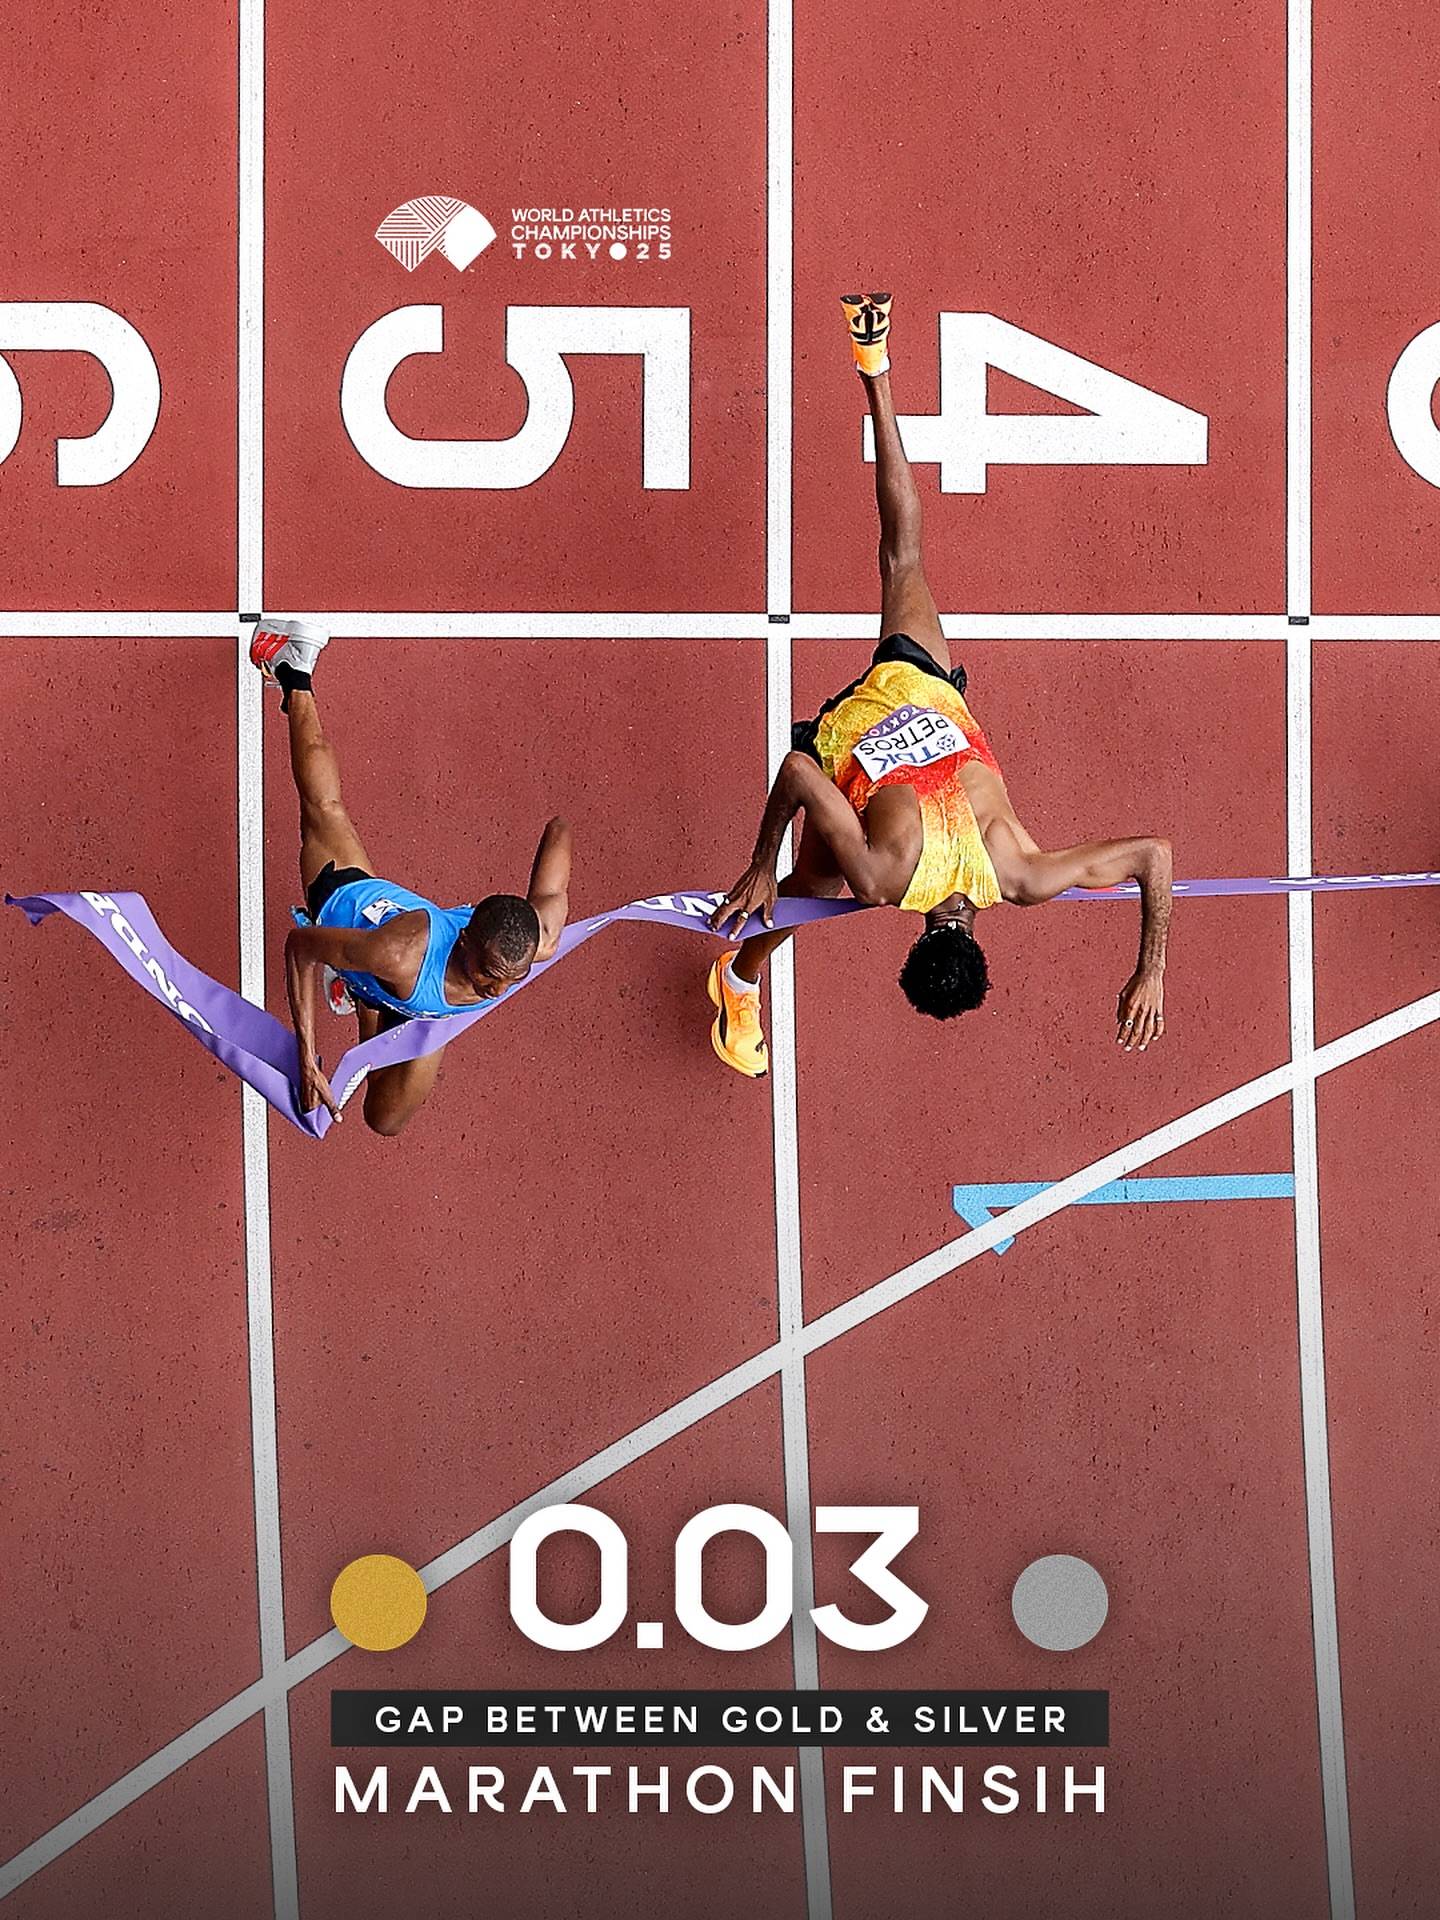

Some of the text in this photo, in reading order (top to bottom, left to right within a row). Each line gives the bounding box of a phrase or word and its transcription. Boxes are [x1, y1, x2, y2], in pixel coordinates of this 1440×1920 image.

[340, 303, 691, 490] 5
[863, 311, 1208, 494] 4
[859, 716, 949, 756] PETROS
[872, 746, 941, 773] TDK
